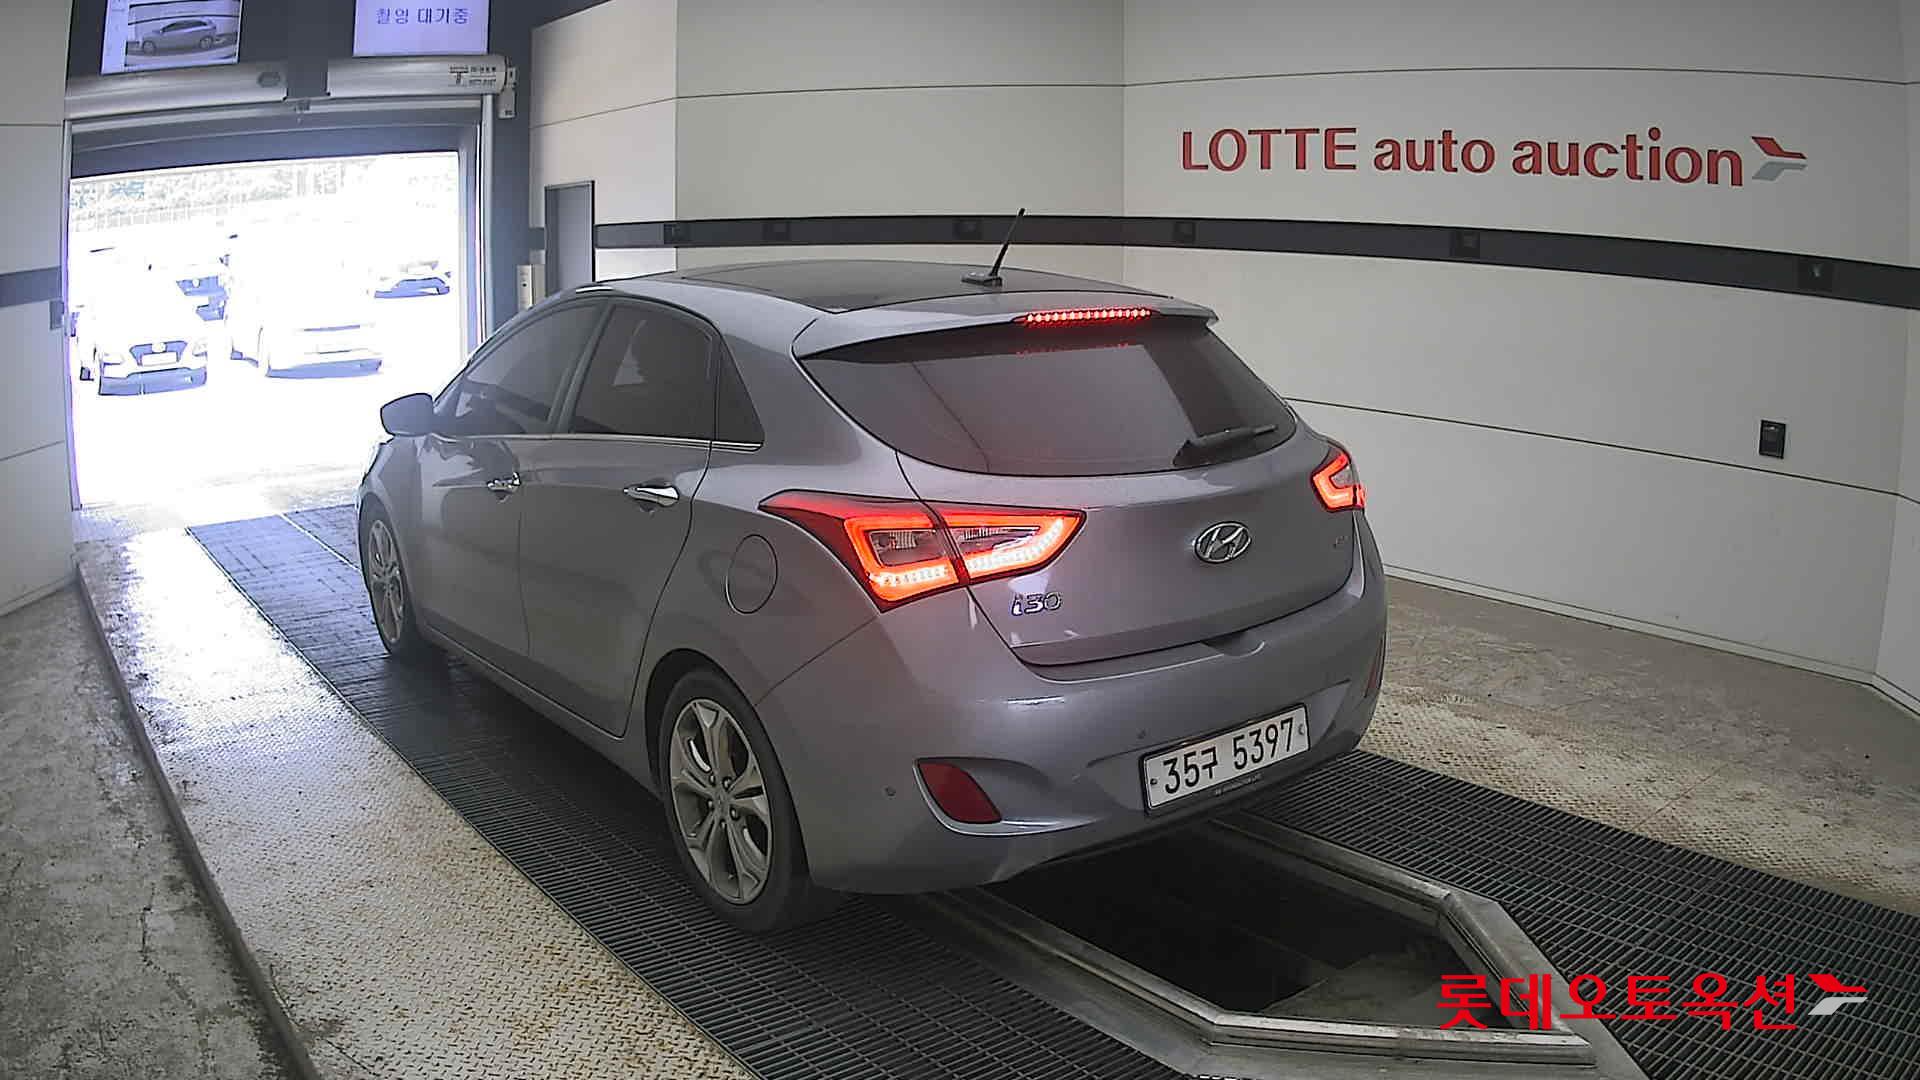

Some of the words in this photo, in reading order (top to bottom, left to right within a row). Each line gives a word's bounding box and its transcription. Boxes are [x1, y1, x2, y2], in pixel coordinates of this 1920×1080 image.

[417, 7, 469, 25] 대기중
[1181, 128, 1357, 171] LOTTE
[1374, 130, 1495, 173] auto
[1512, 127, 1743, 186] auction
[1011, 591, 1061, 616] i30
[1162, 746, 1219, 795] 35구
[1231, 717, 1294, 771] 5397
